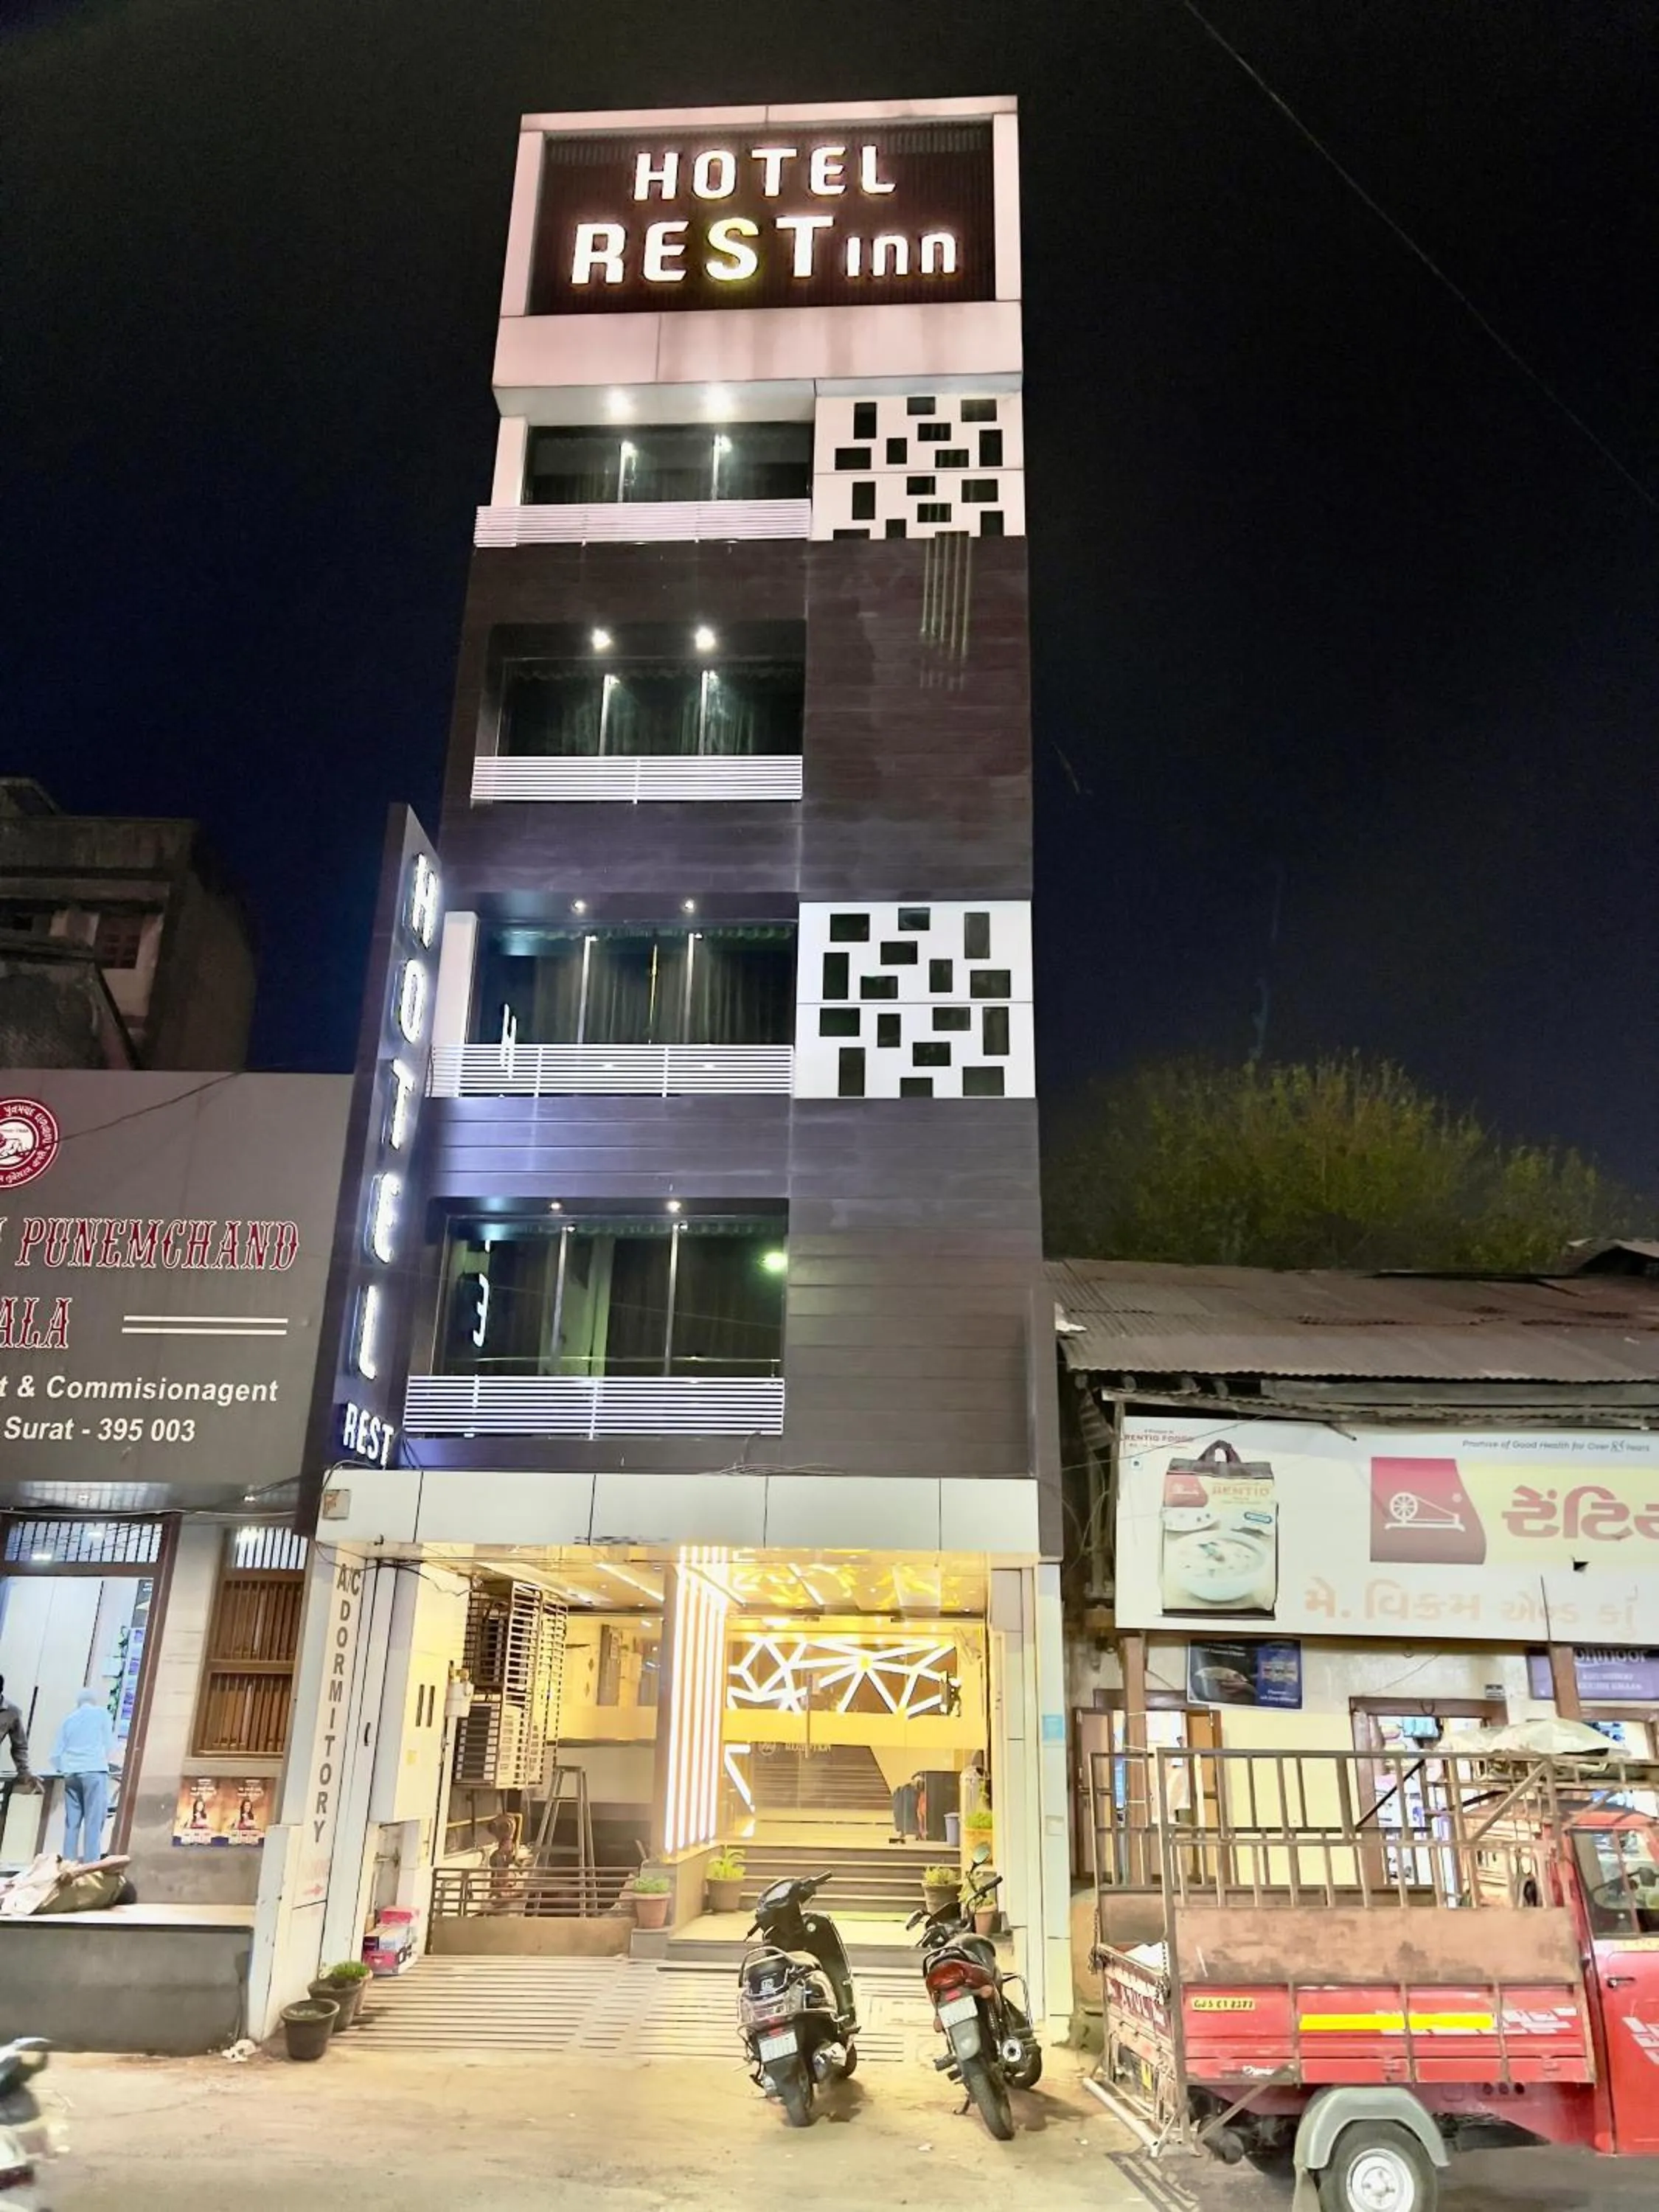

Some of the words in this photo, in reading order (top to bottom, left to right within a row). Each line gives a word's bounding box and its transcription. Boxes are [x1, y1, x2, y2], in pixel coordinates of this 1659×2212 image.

[633, 145, 897, 201] HOTEL
[571, 215, 835, 285] REST
[15, 1217, 299, 1270] PUNEMCHAND
[17, 1375, 35, 1397] &
[46, 1375, 278, 1405] Commisionagent
[4, 1416, 74, 1440] Surat
[97, 1418, 144, 1441] 395
[151, 1419, 196, 1442] 003
[343, 1402, 394, 1467] REST
[1512, 1440, 1537, 1450] Good
[313, 1599, 350, 1843] DORMITORY
